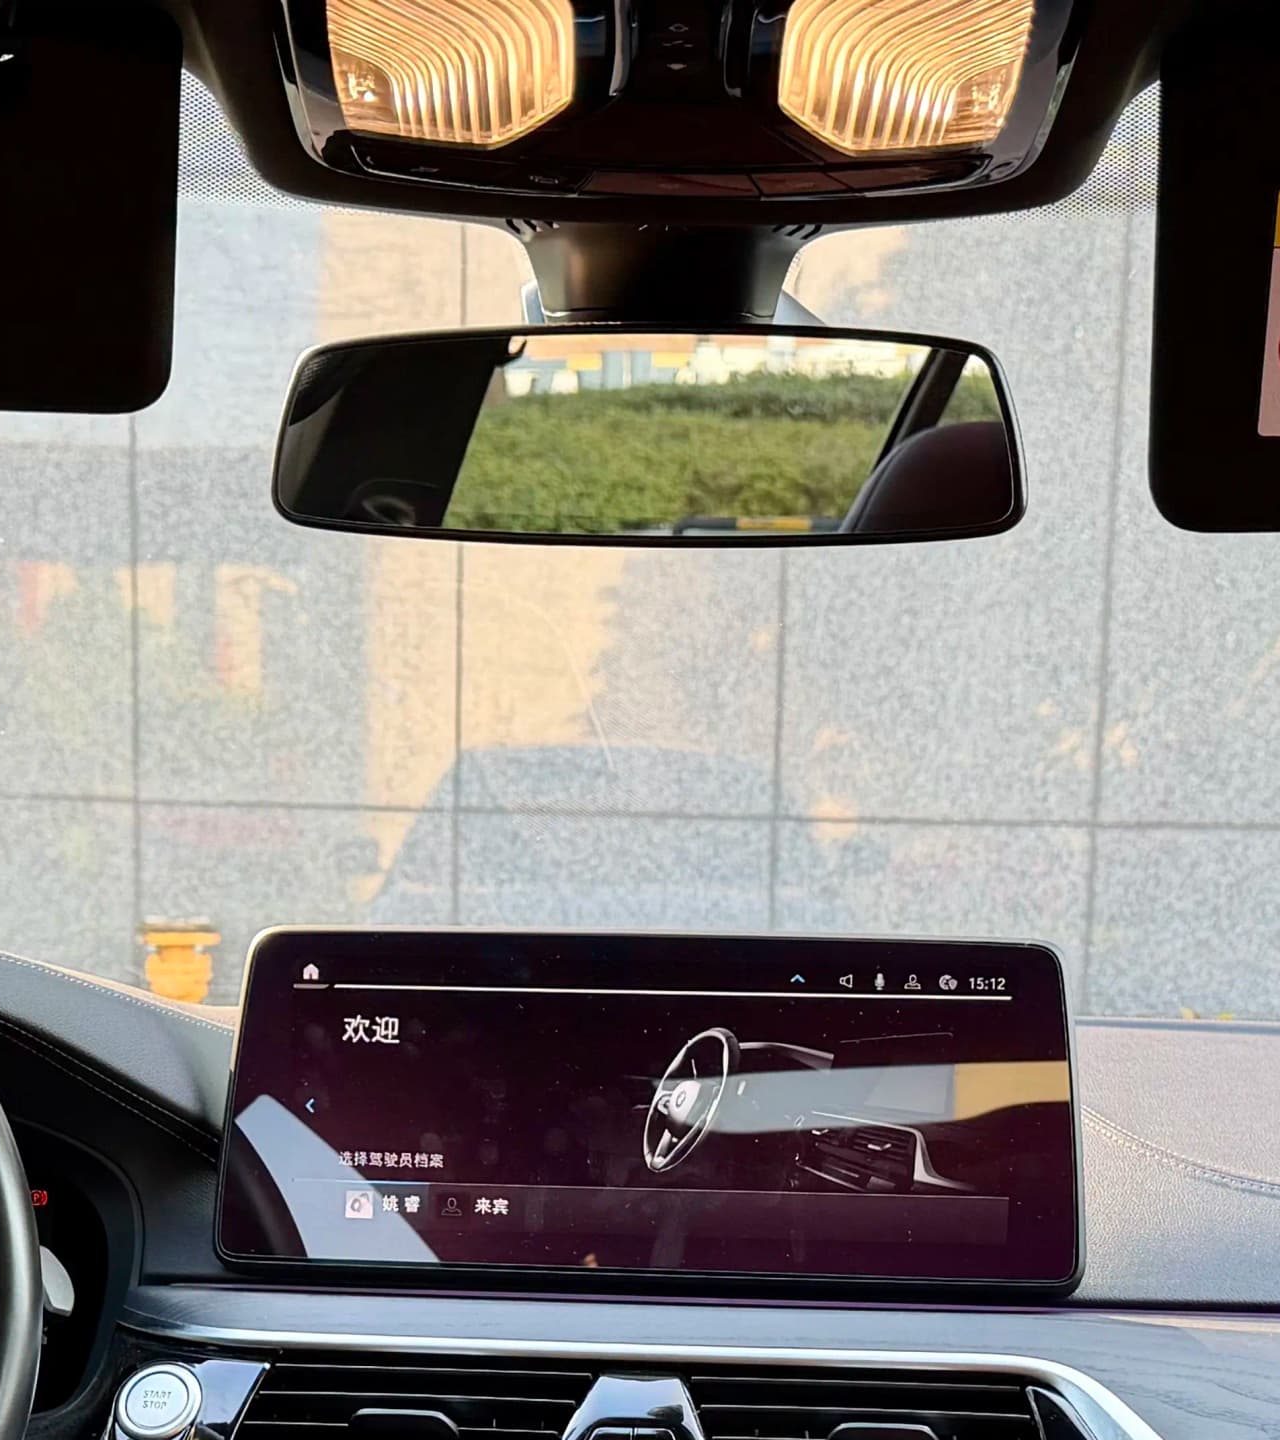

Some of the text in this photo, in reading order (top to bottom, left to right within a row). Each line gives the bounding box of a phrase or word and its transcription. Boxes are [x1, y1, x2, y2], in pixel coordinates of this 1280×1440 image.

[968, 977, 1006, 990] 15:12
[342, 1014, 400, 1044] 欢迎
[338, 1151, 444, 1169] 选择驾驶员档案
[474, 1197, 510, 1215] 来宾
[143, 1390, 172, 1400] START
[142, 1400, 167, 1410] STOP
